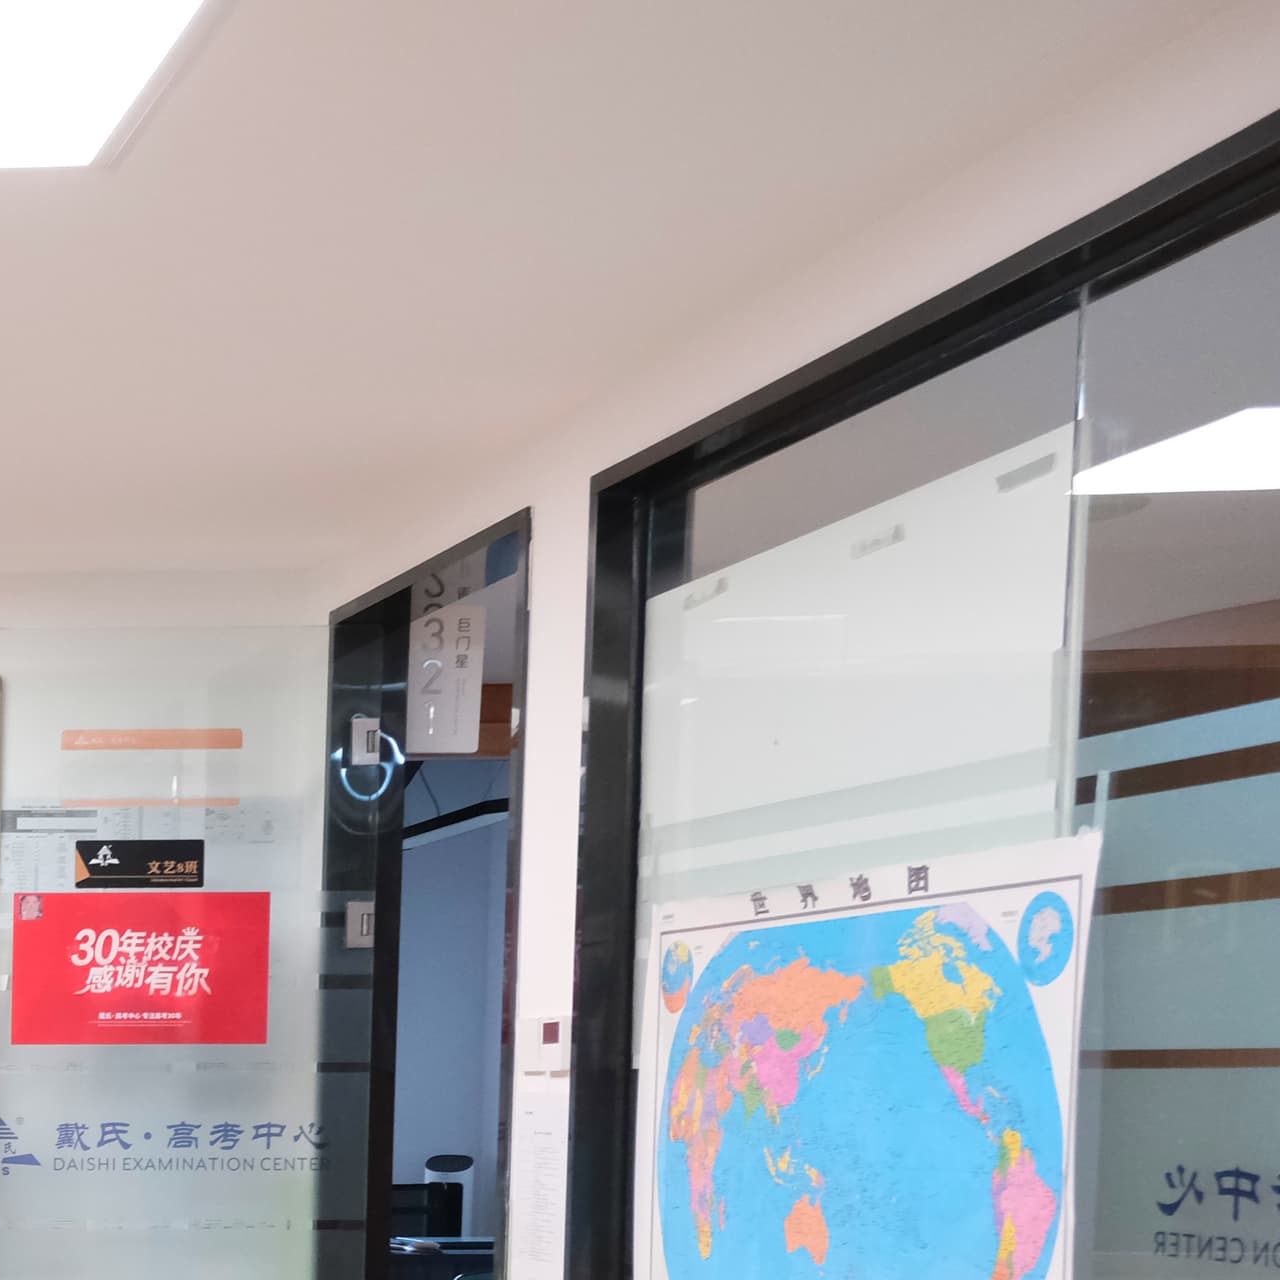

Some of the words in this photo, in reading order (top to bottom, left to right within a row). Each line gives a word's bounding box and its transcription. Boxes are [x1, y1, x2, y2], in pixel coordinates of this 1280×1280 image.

[147, 860, 199, 875] 文艺8班
[749, 864, 930, 917] 世界地图
[71, 926, 204, 966] 30年校庆
[73, 956, 212, 997] 感谢有你
[52, 1157, 119, 1172] DAISHI
[122, 1156, 255, 1172] EXAMINATION
[259, 1156, 330, 1172] CENTER
